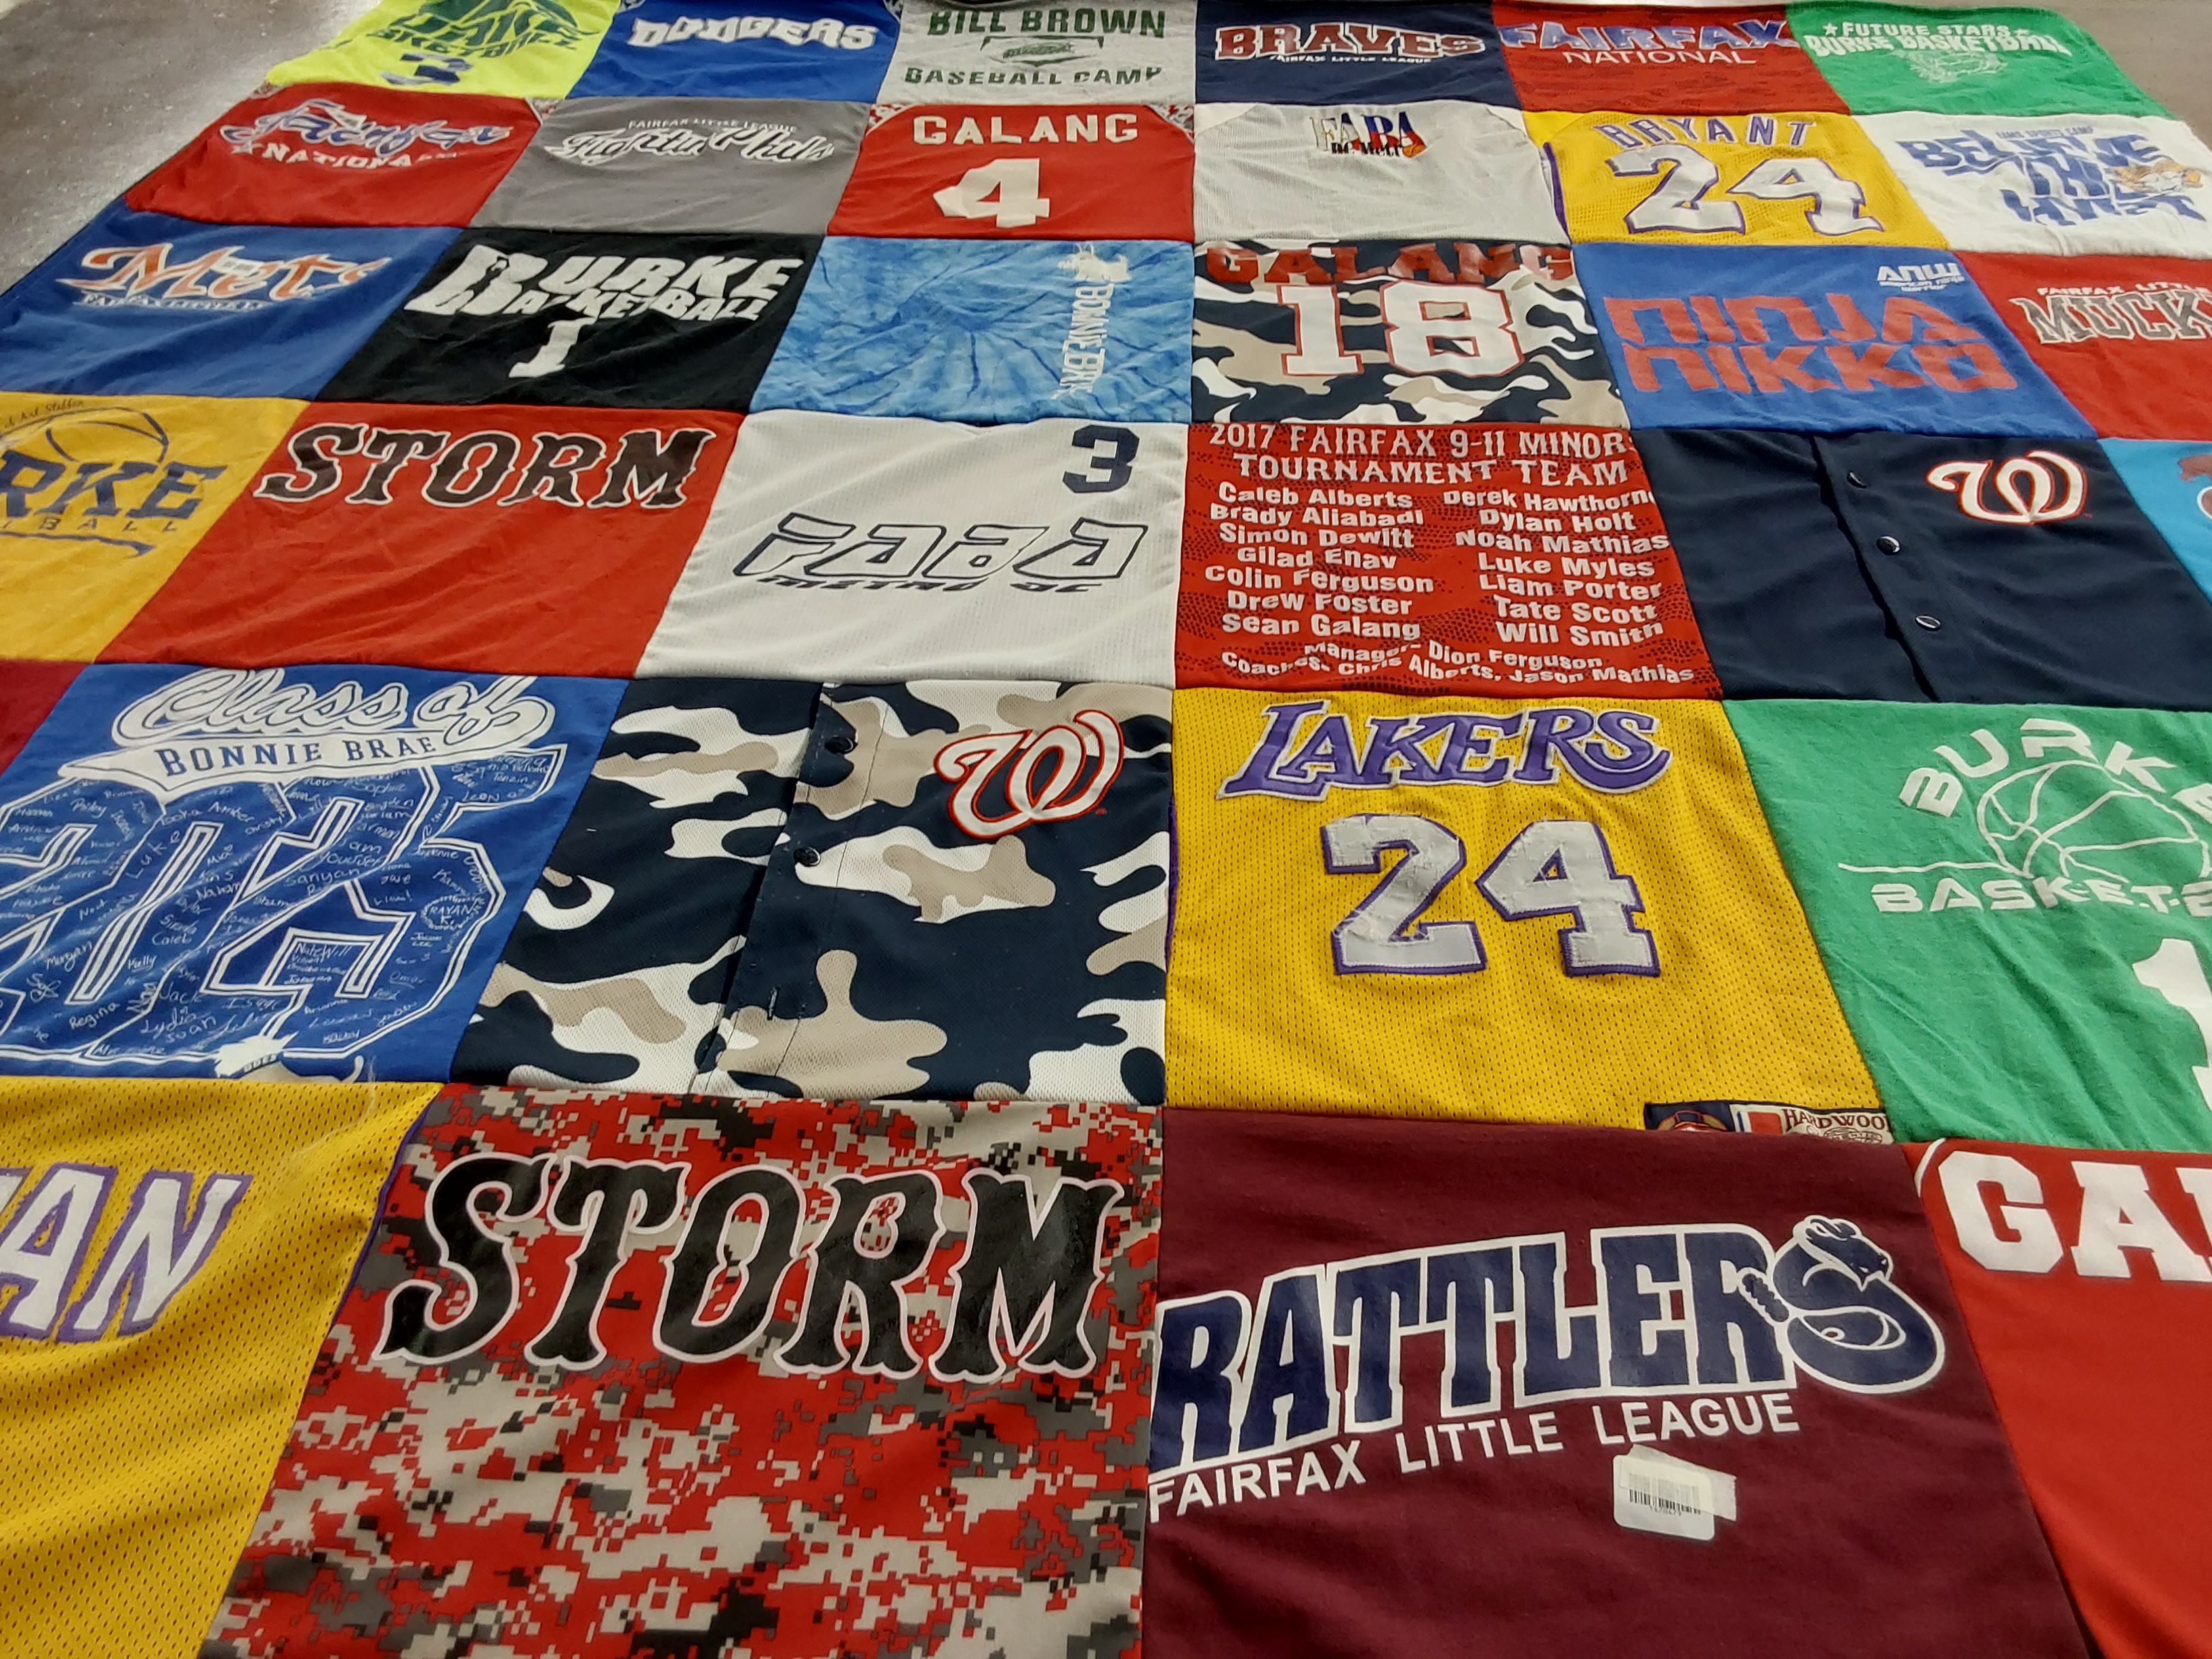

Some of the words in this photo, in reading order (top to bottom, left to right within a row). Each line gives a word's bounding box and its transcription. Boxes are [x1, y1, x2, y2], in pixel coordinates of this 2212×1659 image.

[628, 16, 880, 49] DODGERS
[928, 9, 1007, 35] BILL
[1021, 8, 1166, 38] BROWN
[1497, 20, 1801, 49] FAIRFAX
[1842, 22, 1930, 37] FUTURE
[1937, 24, 2010, 37] STARS
[1215, 22, 1486, 61] BRAVES
[1563, 51, 1757, 64] NATIONAL
[1804, 35, 1895, 57] BURKE
[1901, 35, 2073, 57] BASKETBALL
[905, 67, 1063, 85] BASEBALL
[1073, 67, 1162, 85] CAMP
[913, 113, 1139, 146] GALANG
[1594, 115, 1816, 150] BRYANT
[933, 157, 1050, 228] 4
[1605, 143, 1885, 237] 24
[1206, 243, 1576, 285] GALANG
[2036, 285, 2125, 295] FAIRFAX
[1277, 280, 1525, 377] 18
[1603, 293, 1984, 343] NINJA
[508, 316, 596, 377] 1
[1623, 343, 2018, 394] NIKKO
[1210, 424, 1276, 450] 2017
[1290, 425, 1437, 457] FAIRFAX
[1450, 430, 1505, 458] 9-11
[1519, 431, 1626, 459] MINOR
[253, 423, 716, 509] STORM
[1063, 424, 1140, 493] 3
[1233, 453, 1497, 485] TOURNAMENT
[1512, 459, 1628, 487] TEAM
[1218, 481, 1299, 506] Caleb
[1309, 488, 1414, 508] Alberts
[1443, 488, 1517, 508] Derek
[1925, 449, 2088, 526] W
[1210, 502, 1292, 527] Brady
[1302, 507, 1424, 527] Aliabadi
[1479, 508, 1562, 532] Dylan
[1571, 511, 1637, 534] Holt
[1220, 522, 1308, 545] Simon
[1319, 527, 1416, 548] Dewitt
[1455, 529, 1533, 552] Noah
[1541, 534, 1671, 554] Mathias
[1237, 546, 1314, 567] Gilad
[1325, 548, 1397, 570] Enav
[1478, 552, 1552, 574] Luke
[1561, 556, 1656, 579] Myles
[1205, 565, 1282, 589] Colin
[1293, 568, 1435, 593] Ferguson
[1479, 573, 1554, 597] Liam
[1562, 579, 1662, 601] Porter
[1227, 590, 1305, 611] Drew
[1315, 593, 1413, 615] Foster
[1492, 594, 1561, 621] Tate
[1570, 602, 1659, 625] Scott
[1222, 613, 1300, 635] Sean
[1311, 613, 1421, 641] Galang
[1494, 620, 1559, 644] Will
[1570, 620, 1664, 647] Smith
[1338, 656, 1403, 676] Chris
[1408, 653, 1502, 682] Alberts,
[1509, 669, 1584, 685] Jason
[1592, 663, 1695, 684] Mathias
[1429, 639, 1481, 665] Dion
[1488, 649, 1603, 671] Ferguson
[112, 667, 409, 747] Class
[411, 675, 556, 747] of
[154, 742, 323, 777] BONNIE
[342, 737, 437, 762] BRAE
[1215, 699, 1672, 802] LAKERS
[933, 710, 1125, 840] W
[1319, 813, 1662, 977] 24
[1782, 1108, 1891, 1132] HARDWOO
[370, 1152, 1126, 1384] STORM
[1149, 1214, 1945, 1476] RATTLERS
[1148, 1438, 1366, 1523] FAIRFAX
[1396, 1411, 1563, 1474] LITTLE
[1591, 1391, 1800, 1445] LEAGUE
